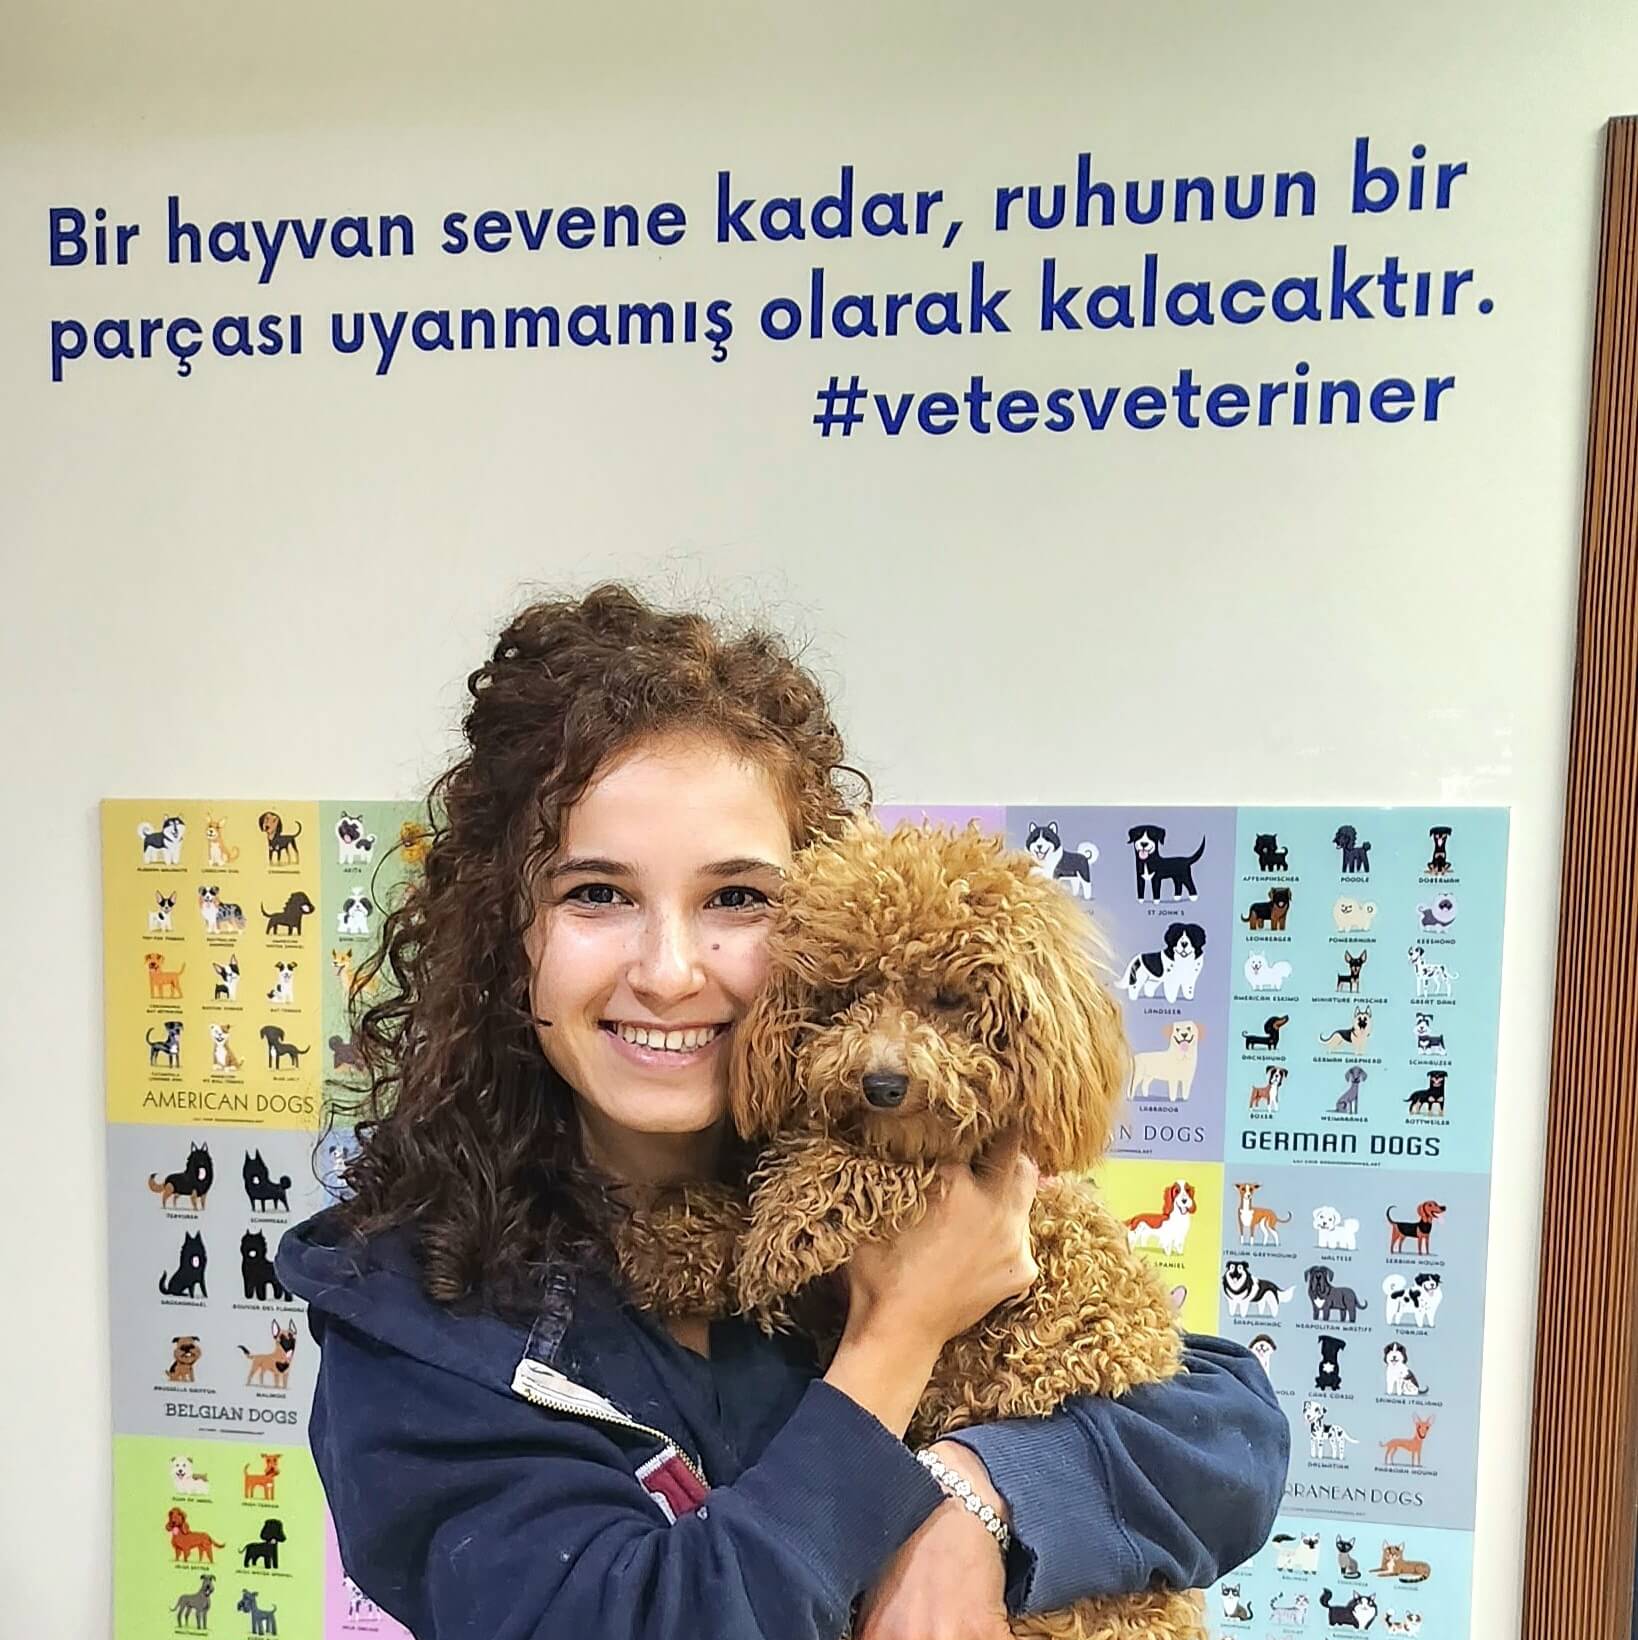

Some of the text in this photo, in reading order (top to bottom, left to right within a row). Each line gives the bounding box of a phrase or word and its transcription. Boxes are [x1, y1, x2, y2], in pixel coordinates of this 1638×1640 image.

[49, 136, 1467, 284] Bir hayvan sevene kadar, ruhunun bir
[51, 244, 1494, 381] parçası uyanmamış olarak kalacaktır.
[812, 361, 1455, 437] #vetesveteriner
[143, 1091, 314, 1113] AMERICAN DOGS
[1405, 1118, 1450, 1126] ROTTWEILER
[1144, 1125, 1205, 1143] DOGS
[1241, 1131, 1440, 1156] GERMAN DOGS
[1296, 1323, 1341, 1331] NEAPOLITAN
[166, 1403, 297, 1424] BELGIAN DOGS
[1371, 1488, 1424, 1506] DOGS
